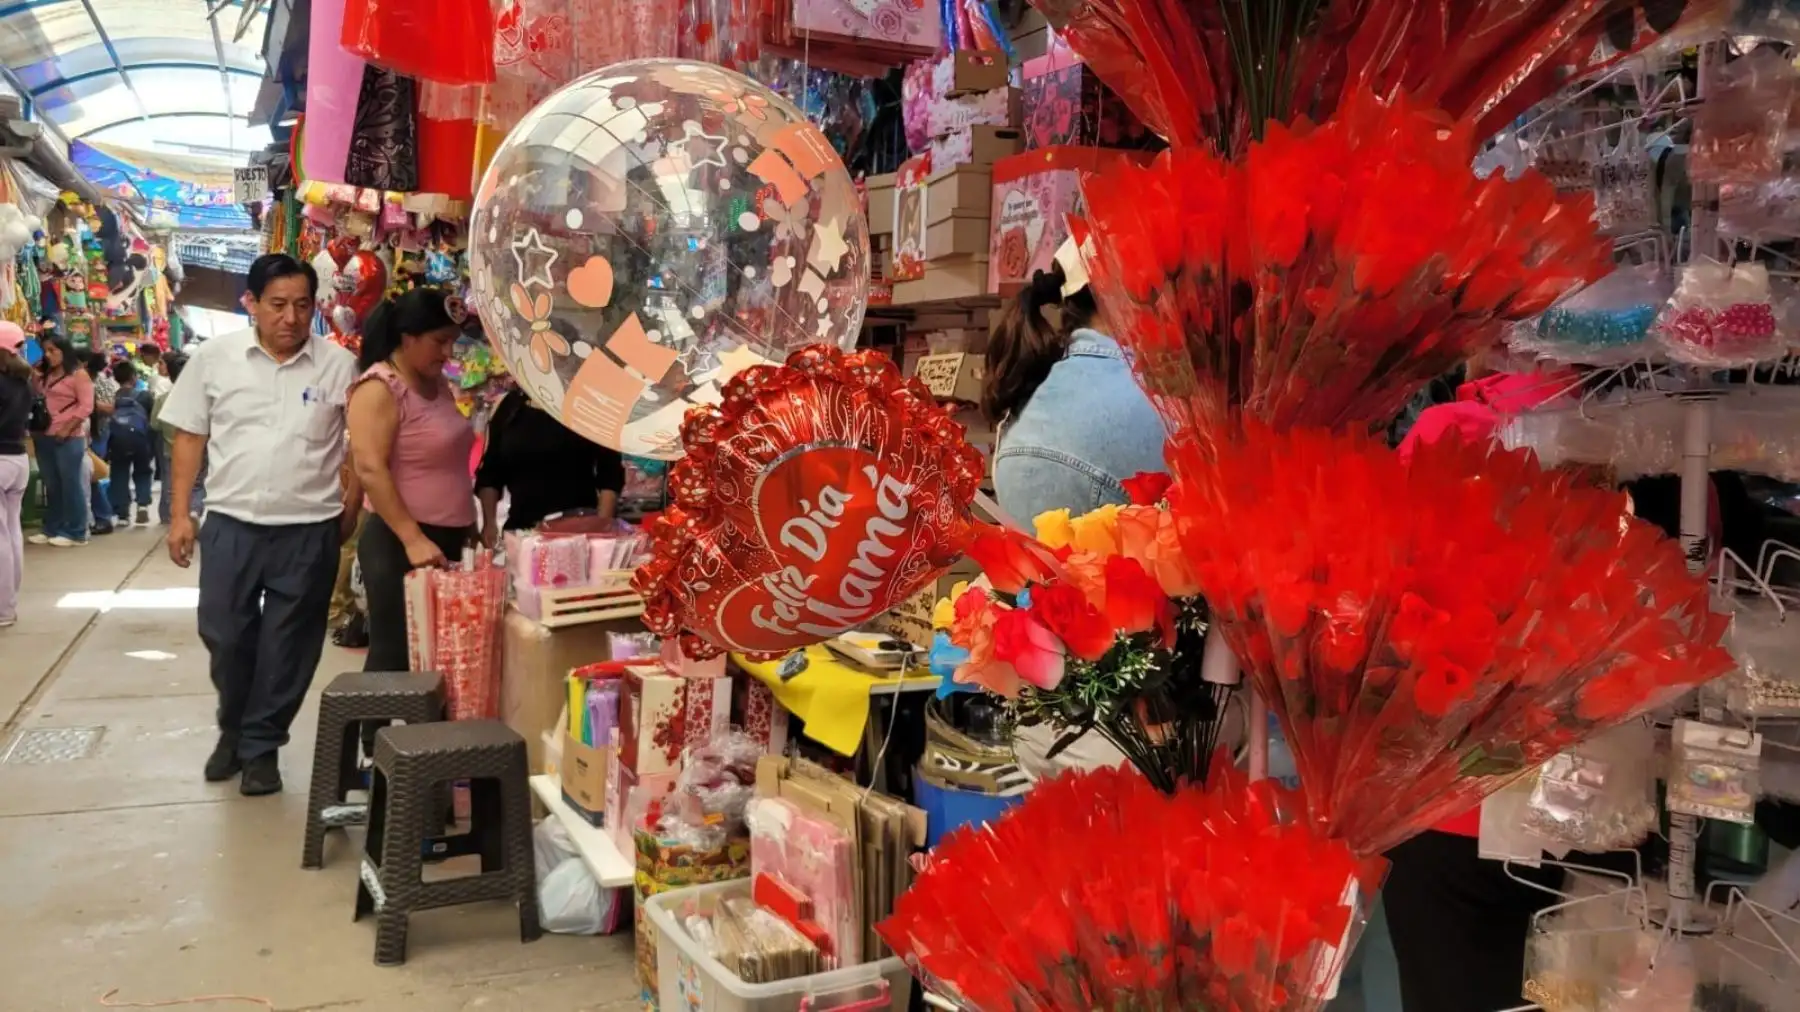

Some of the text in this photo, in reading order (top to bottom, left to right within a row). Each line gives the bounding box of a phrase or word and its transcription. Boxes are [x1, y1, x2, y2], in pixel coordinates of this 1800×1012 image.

[233, 167, 266, 182] PUESTO
[751, 484, 854, 635] Feliz Día
[796, 464, 917, 638] Mamá
